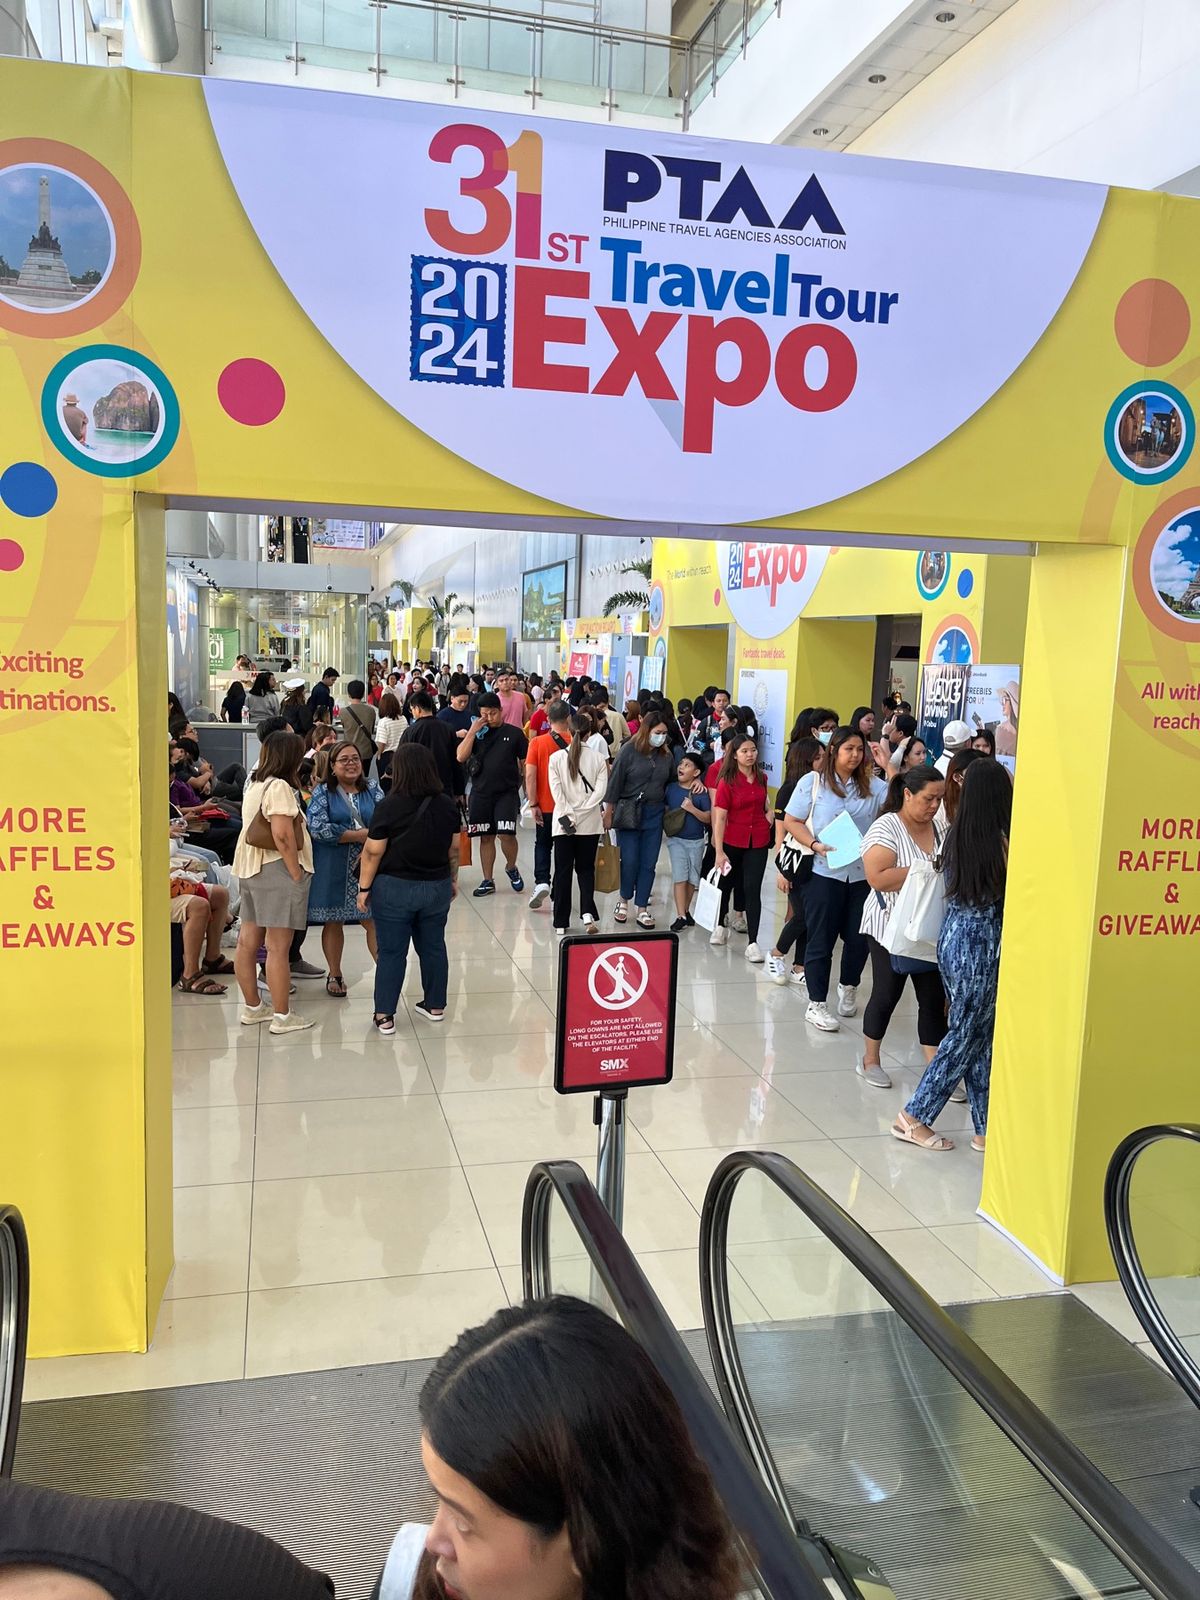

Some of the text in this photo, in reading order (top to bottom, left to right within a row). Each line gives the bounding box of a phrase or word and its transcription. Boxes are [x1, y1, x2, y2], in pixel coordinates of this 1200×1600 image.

[603, 216, 847, 251] PHILIPPINE TRAVEL AGENCIES ASSOCIATION
[511, 264, 859, 454] Expo
[742, 542, 808, 607] Expo
[0, 650, 84, 679] xciting
[966, 686, 992, 696] FREEBIES
[966, 696, 977, 704] FOR
[1141, 682, 1164, 700] All
[924, 705, 948, 718] DIVING
[1153, 712, 1200, 730] reach
[497, 820, 516, 831] MAN
[0, 846, 116, 871] FFLES
[1117, 850, 1200, 872] RAFFL
[33, 884, 55, 910] &
[1164, 882, 1180, 904] &
[584, 1039, 617, 1047] ELEVATORS
[600, 1058, 629, 1071] SMX
